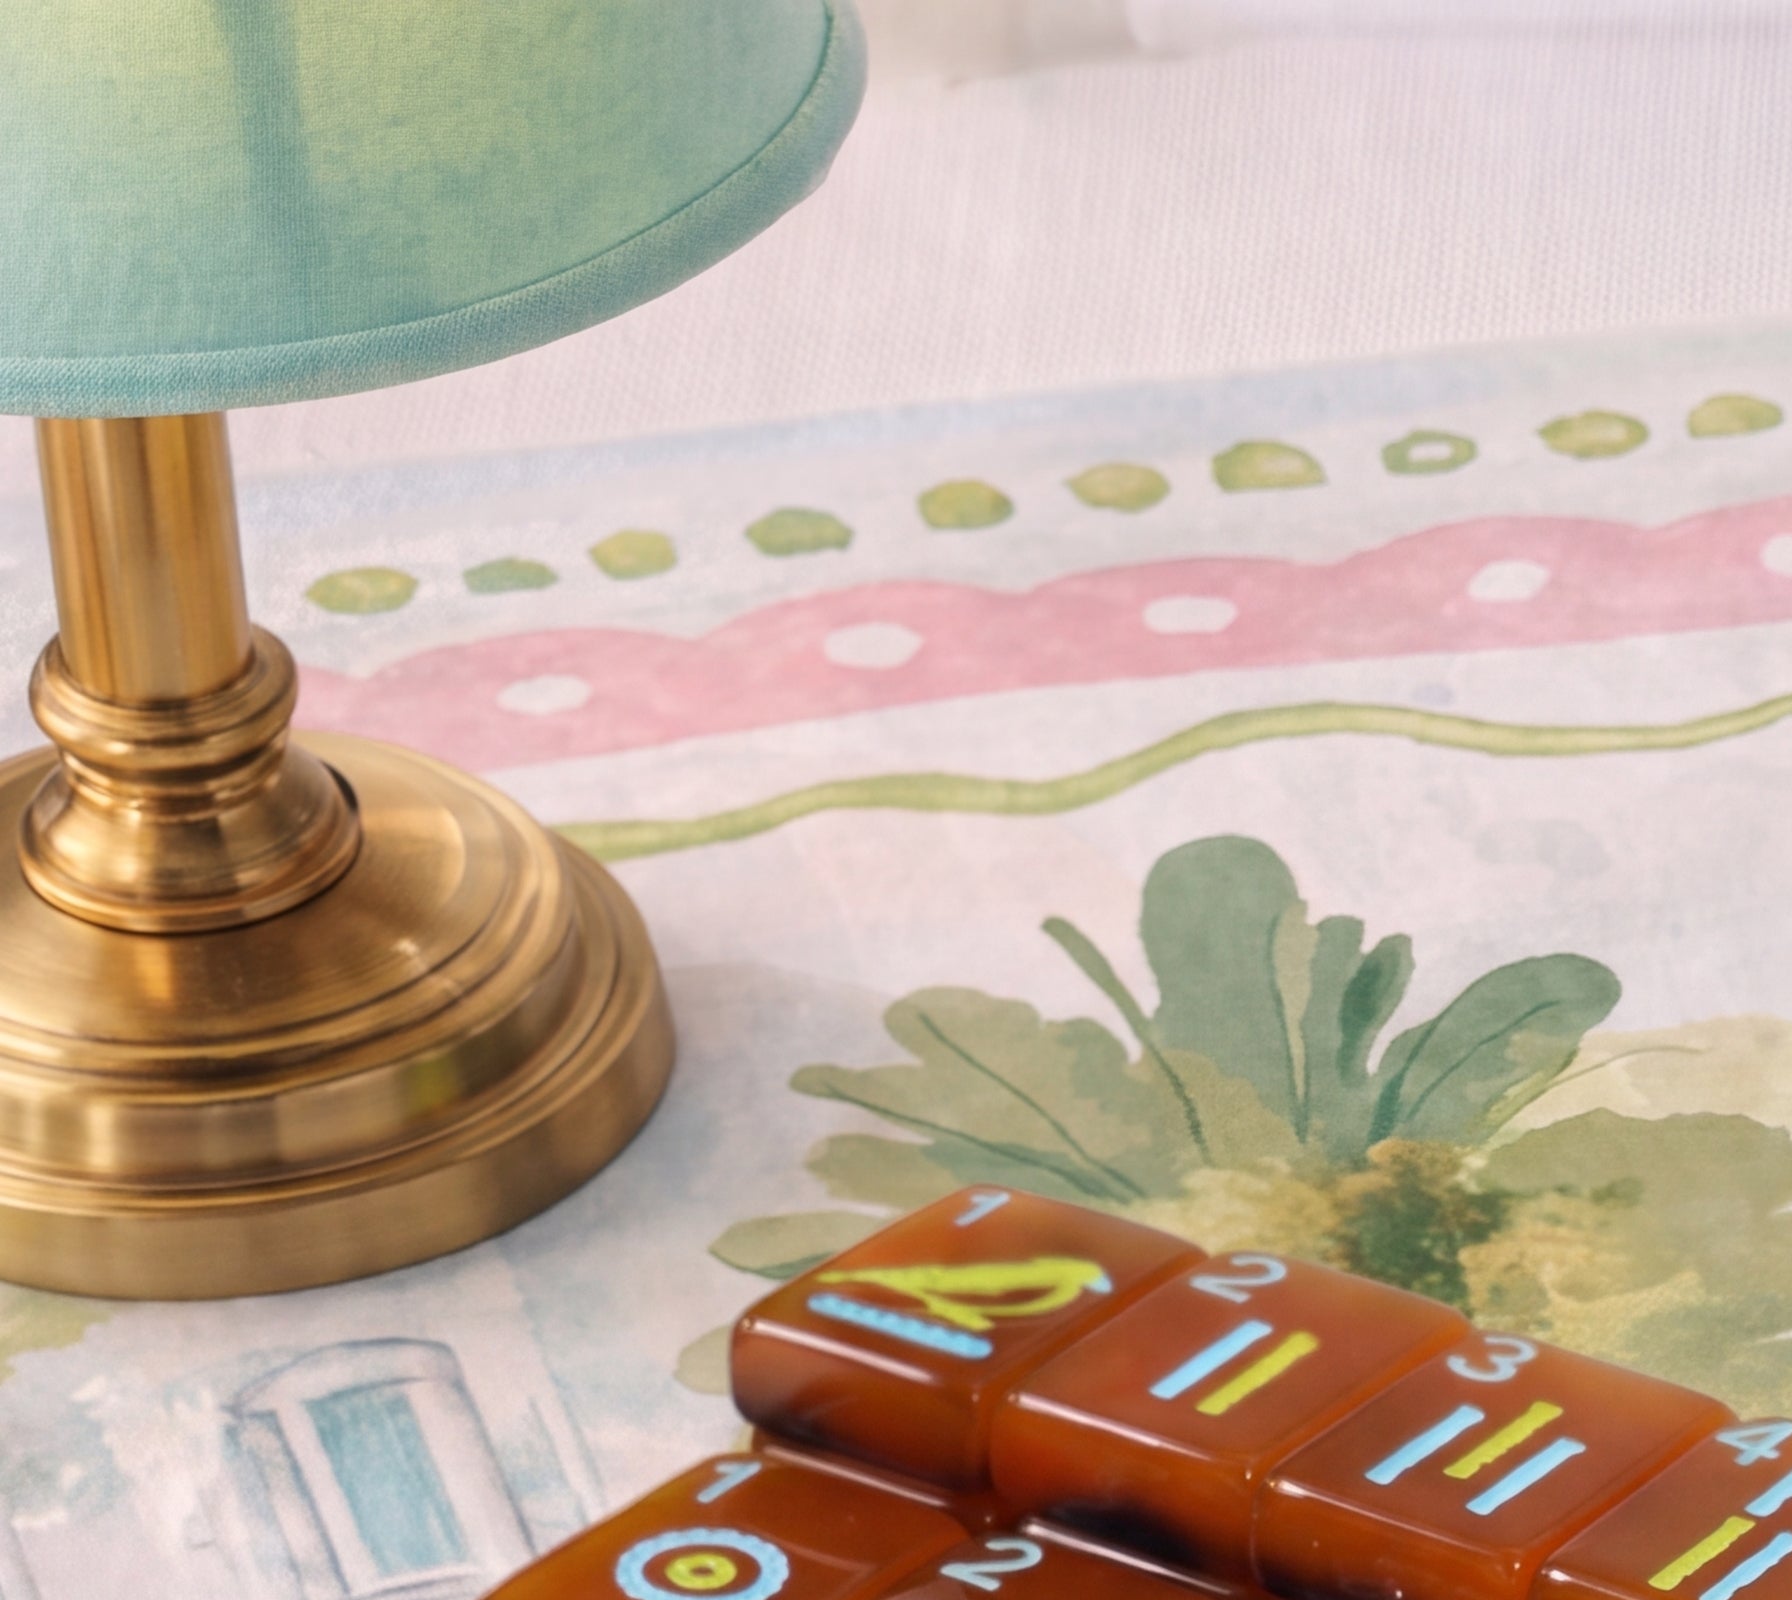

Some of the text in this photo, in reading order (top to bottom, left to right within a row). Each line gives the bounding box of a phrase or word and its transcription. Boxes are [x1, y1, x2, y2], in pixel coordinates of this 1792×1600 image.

[956, 1192, 1009, 1225] 1
[1191, 1255, 1287, 1304] 2
[1447, 1336, 1535, 1383] 3
[697, 1461, 761, 1504] 1
[939, 1537, 1044, 1592] 2
